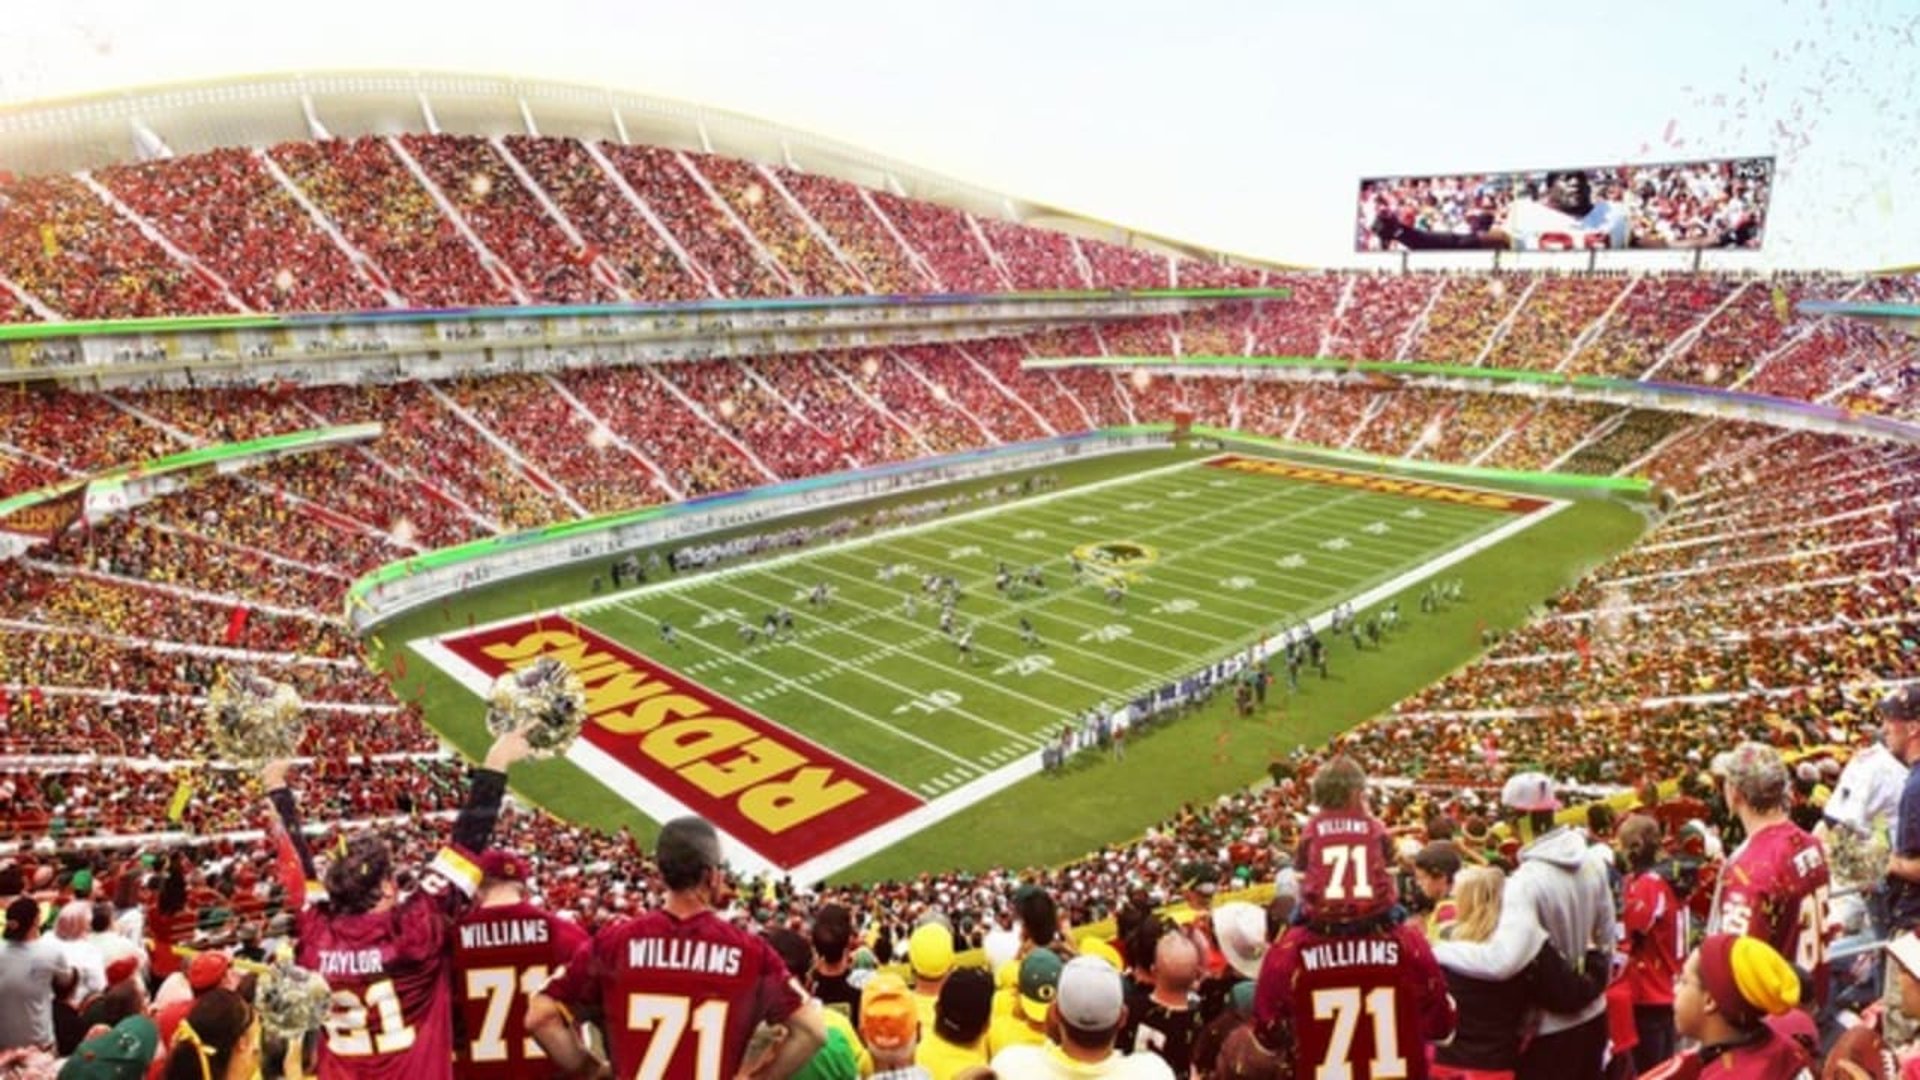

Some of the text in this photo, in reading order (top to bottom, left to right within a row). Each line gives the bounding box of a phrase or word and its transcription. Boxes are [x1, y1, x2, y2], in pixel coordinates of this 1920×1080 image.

[1316, 816, 1369, 837] WILLIAMS
[1321, 845, 1373, 900] 71
[460, 919, 549, 949] WILLIAMS
[318, 948, 384, 975] TAYLOR
[628, 938, 742, 976] WILLIAMS
[1301, 940, 1400, 971] WILLIAMS
[325, 978, 417, 1056] 21
[626, 992, 730, 1080] 71
[1312, 986, 1408, 1080] 71
